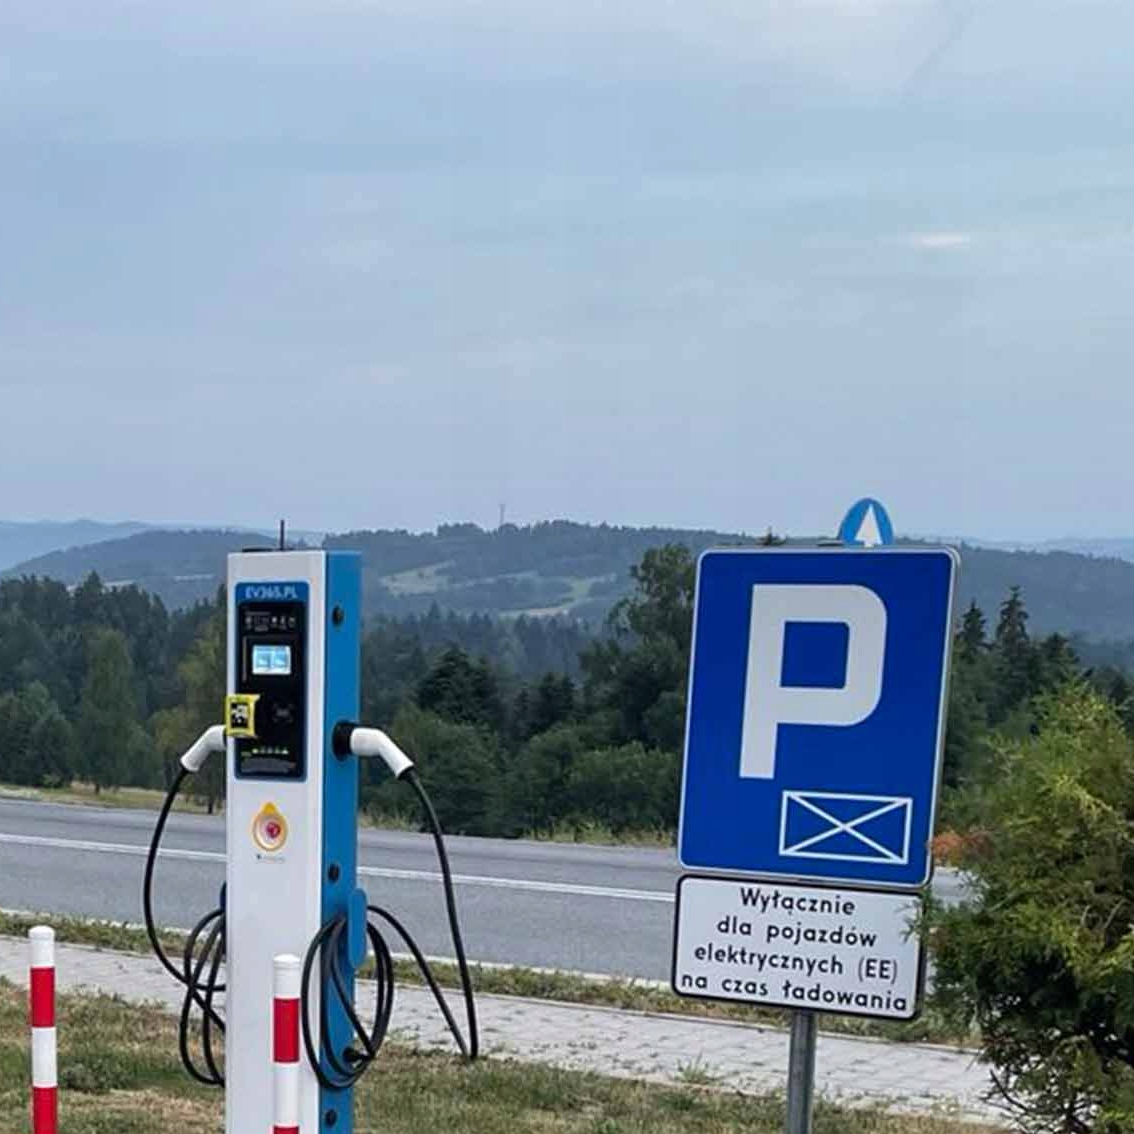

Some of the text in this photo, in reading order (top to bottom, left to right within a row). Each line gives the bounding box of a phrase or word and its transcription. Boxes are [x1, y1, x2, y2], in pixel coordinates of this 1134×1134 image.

[739, 584, 887, 779] P
[740, 887, 855, 915] Wyłącznie
[717, 915, 877, 947] dla pojazdów
[694, 943, 898, 984] elektrycznych (EE)
[681, 974, 907, 1011] na czas ładowania
